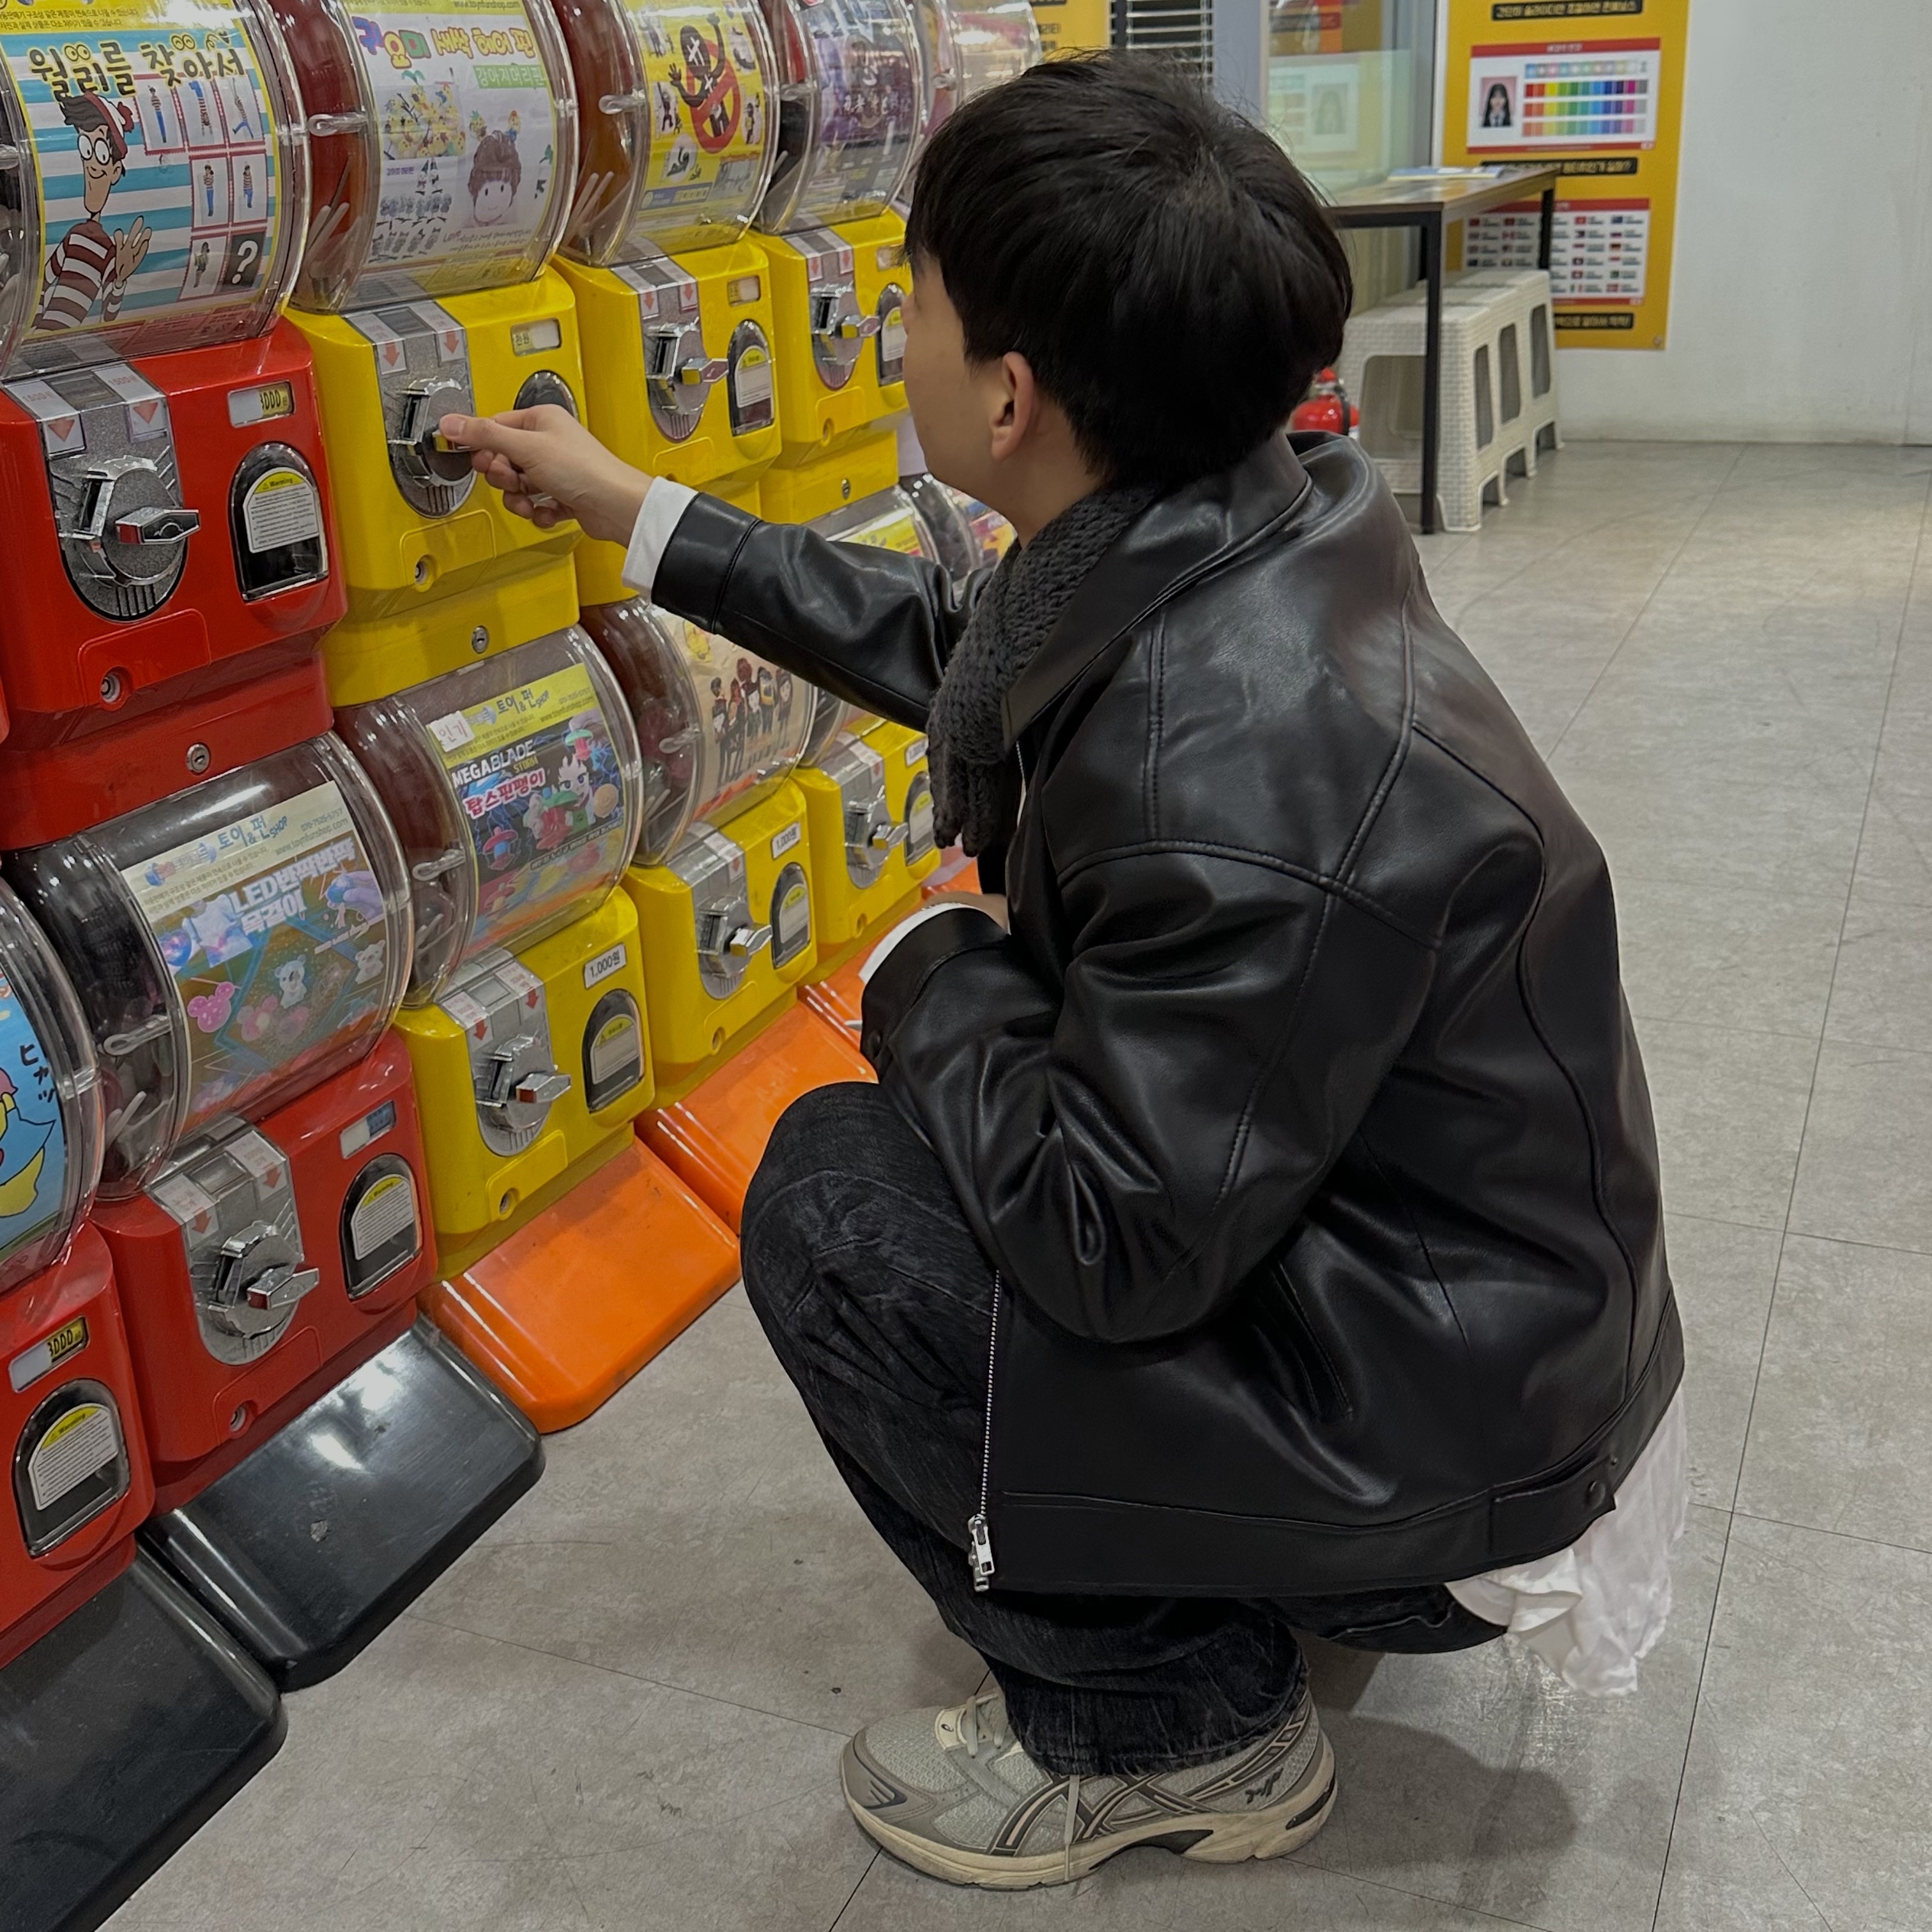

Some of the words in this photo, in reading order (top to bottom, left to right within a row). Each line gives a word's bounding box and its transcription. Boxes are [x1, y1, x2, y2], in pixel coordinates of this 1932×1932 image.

[0, 11, 26, 19] 동판매기
[29, 42, 135, 102] 월리를
[141, 43, 245, 87] 찾아서
[439, 719, 468, 742] 인기
[452, 739, 536, 789] MEGABLADE
[241, 888, 307, 935] 목걸이
[590, 949, 620, 977] 1,000원
